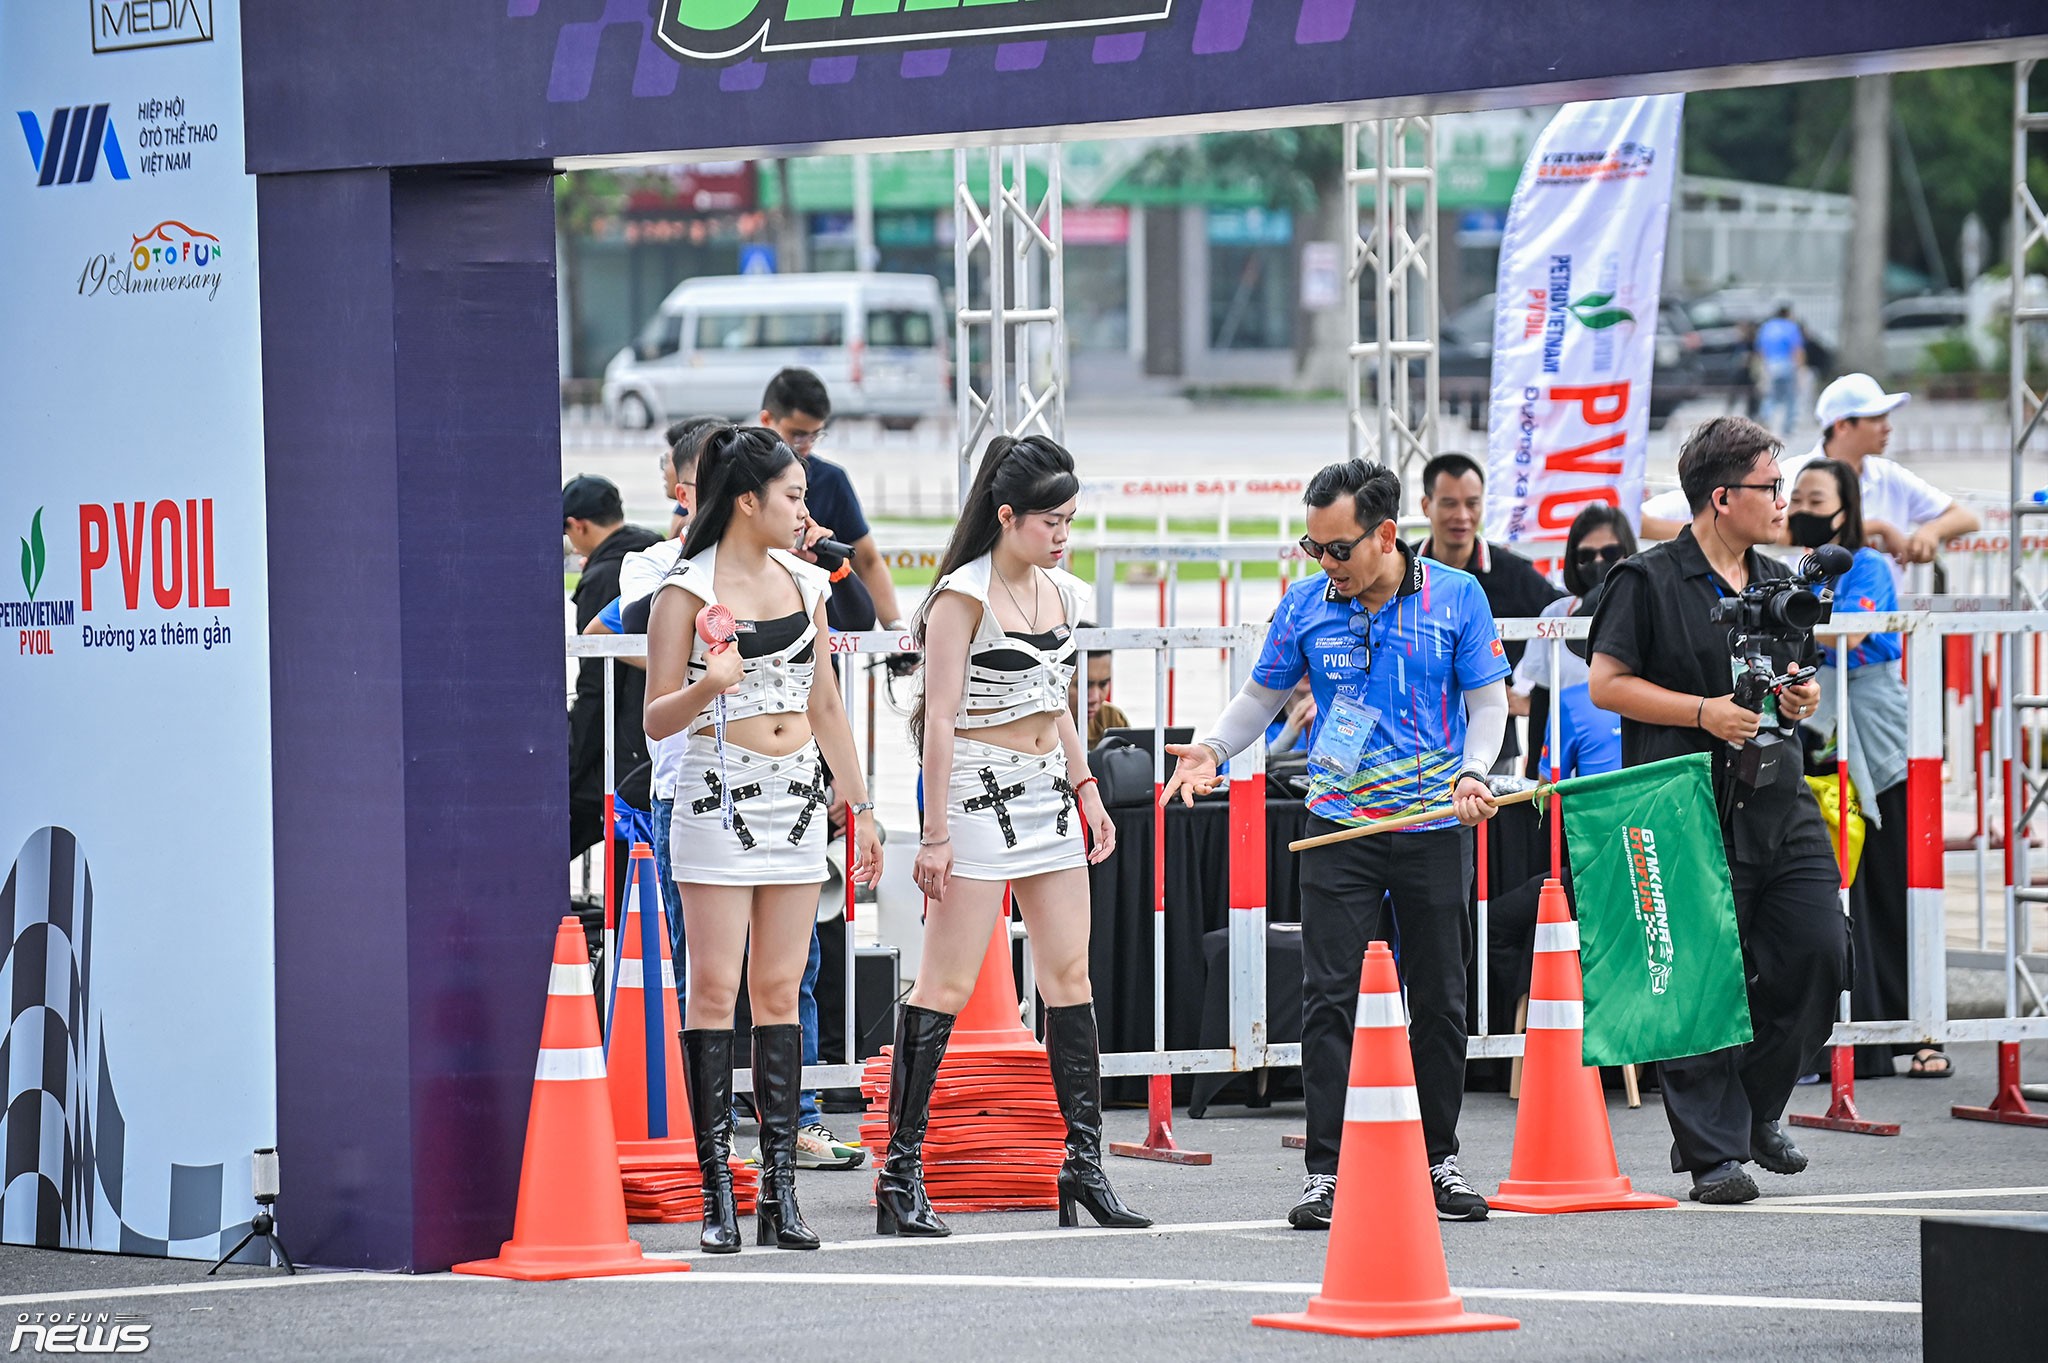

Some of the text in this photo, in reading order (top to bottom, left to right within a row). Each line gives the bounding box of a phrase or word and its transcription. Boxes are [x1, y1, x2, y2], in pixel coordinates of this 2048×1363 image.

[101, 0, 206, 38] MEDIA
[138, 95, 185, 124] HIỆP HỘI
[139, 120, 218, 149] ÔTÔ THỂ THAO
[140, 151, 191, 177] VIỆT NAM
[133, 241, 221, 271] OTOFUN
[107, 261, 221, 302] Anniversary
[1523, 288, 1547, 339] PVOIL
[1543, 254, 1572, 373] PETROVIETNAM
[1514, 471, 1530, 497] xa
[79, 498, 230, 612] PVOIL
[0, 600, 74, 627] PETROVIETNAM
[1537, 619, 1567, 638] SÁT
[20, 630, 54, 655] PVOIL
[82, 615, 231, 652] Đường xa thêm gần
[829, 633, 861, 652] SÁT
[1621, 826, 1643, 920] CHAMPIONSHIP SERIES
[1629, 827, 1655, 912] OTOFUN
[1641, 828, 1669, 943] GYMKHANA
